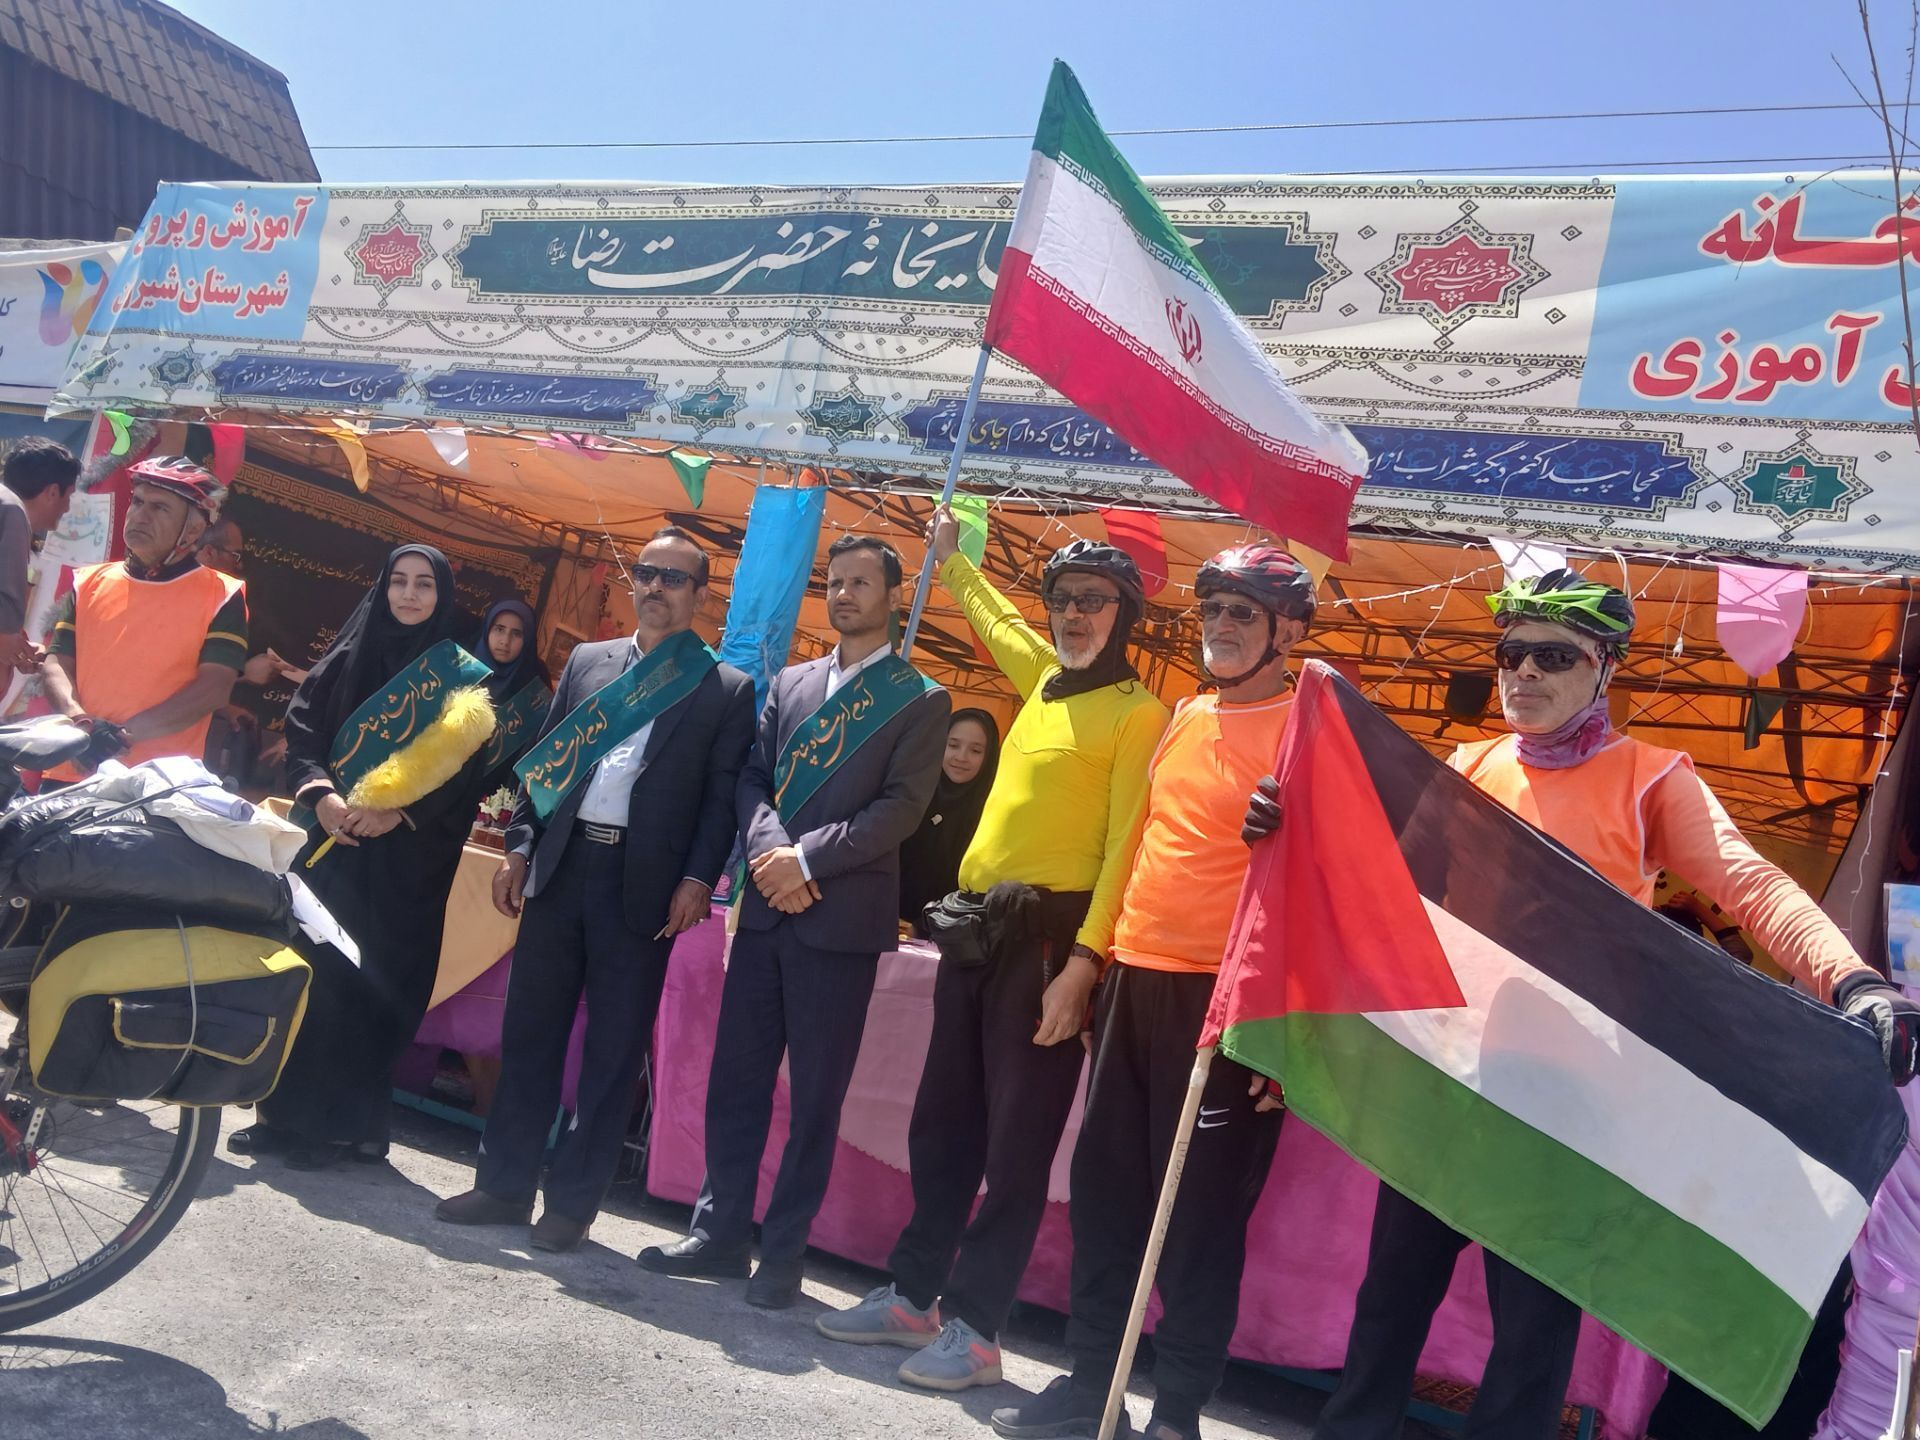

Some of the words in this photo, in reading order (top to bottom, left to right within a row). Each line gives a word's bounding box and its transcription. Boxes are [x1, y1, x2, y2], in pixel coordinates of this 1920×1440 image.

[134, 209, 188, 256] پرو
[186, 214, 206, 249] و
[208, 197, 314, 252] آموزش
[571, 223, 627, 270] رضا
[1701, 193, 1920, 265] خانه
[587, 220, 853, 296] حضرت
[177, 265, 290, 318] شهرستان
[1632, 311, 1879, 401] آموزی
[968, 417, 1008, 450] چای
[1400, 447, 1477, 481] شراب
[1632, 461, 1687, 502] کجا
[48, 1243, 119, 1291] OVERLOAD
